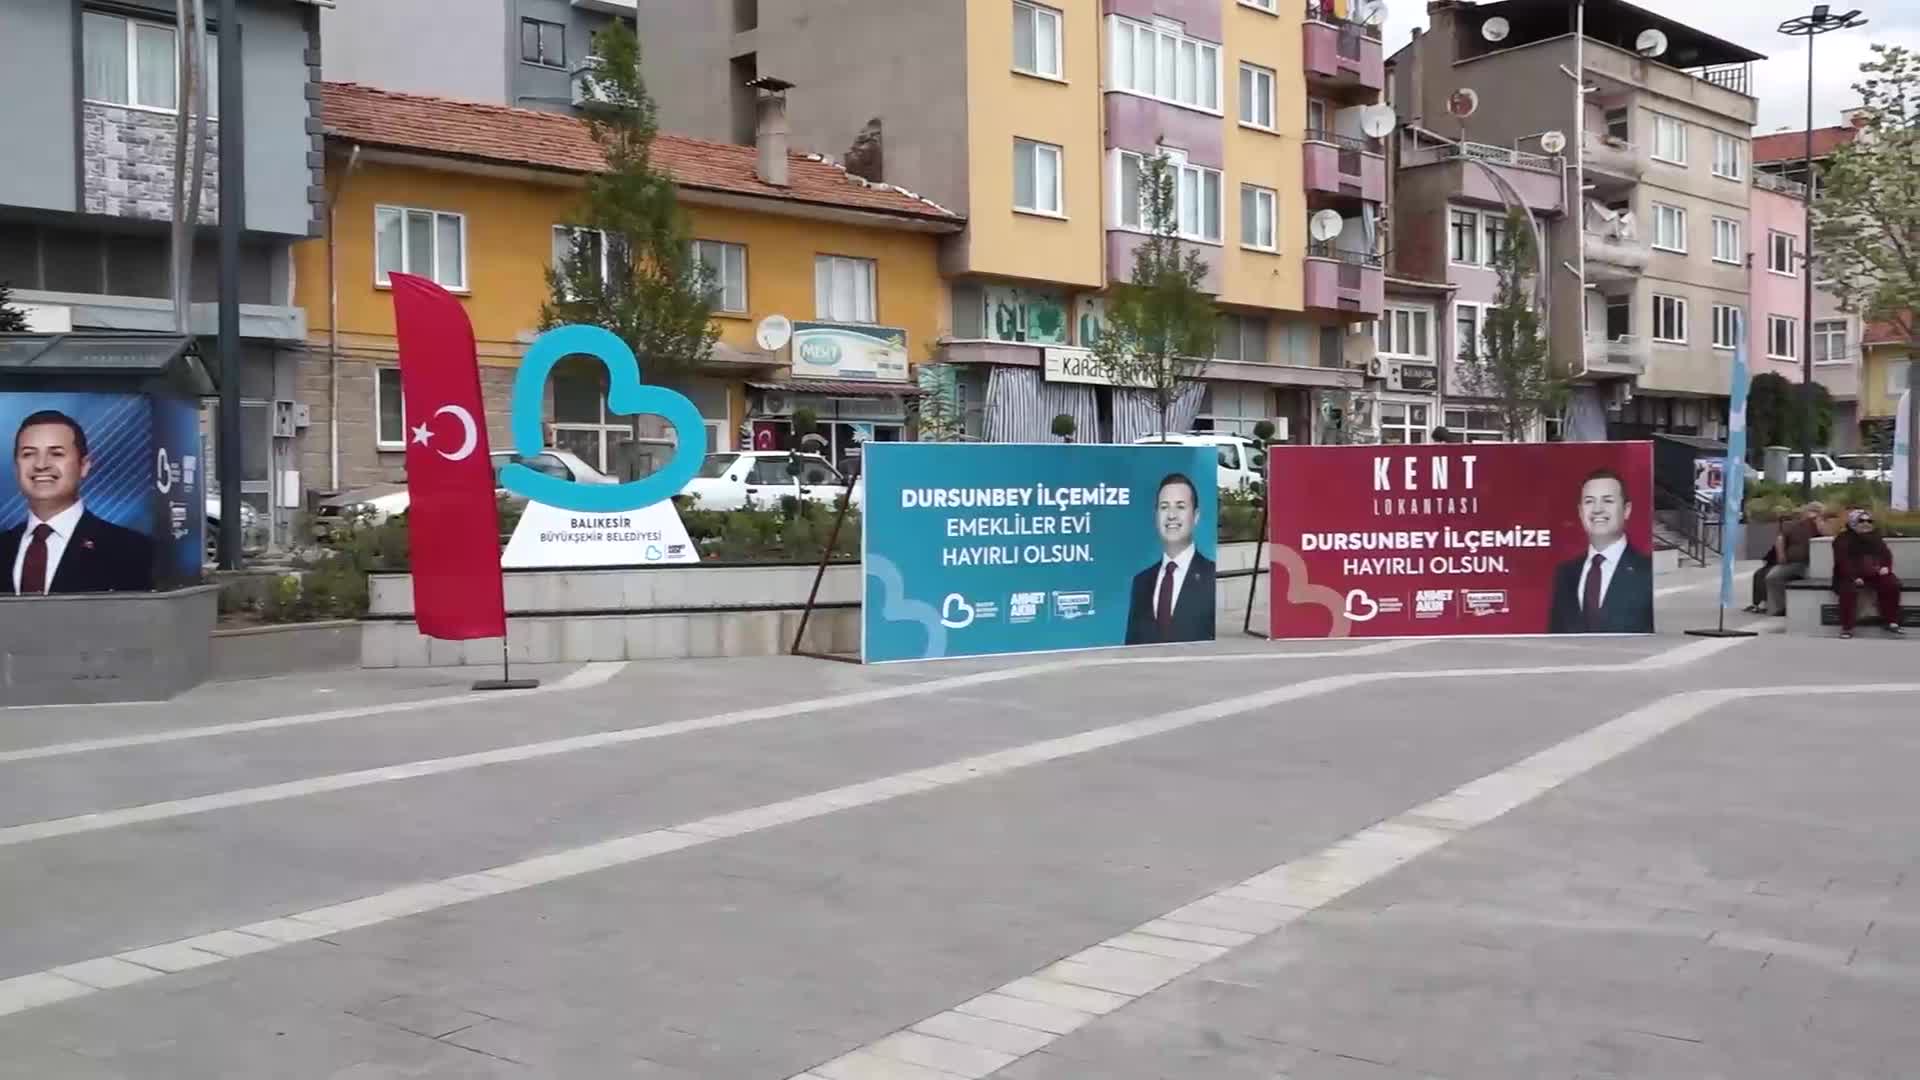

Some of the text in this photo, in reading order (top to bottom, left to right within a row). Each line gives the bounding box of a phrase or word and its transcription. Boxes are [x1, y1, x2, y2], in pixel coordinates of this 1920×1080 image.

[1373, 455, 1477, 491] KENT
[901, 483, 1130, 511] DURSUNBEY İLÇEMİZE
[1373, 497, 1478, 515] LOKANTASI
[570, 516, 631, 528] BALIKESİR
[947, 511, 1091, 537] EMEKLİLER EVİ
[540, 531, 662, 544] BÜYÜKŞEHİR BELEDİYESİ
[1301, 525, 1551, 552] DURSUNBEY İLÇEMİZE
[943, 544, 1094, 566] HAYIRLI OLSUN.
[1343, 556, 1509, 576] HAYIRLI OLSUN.
